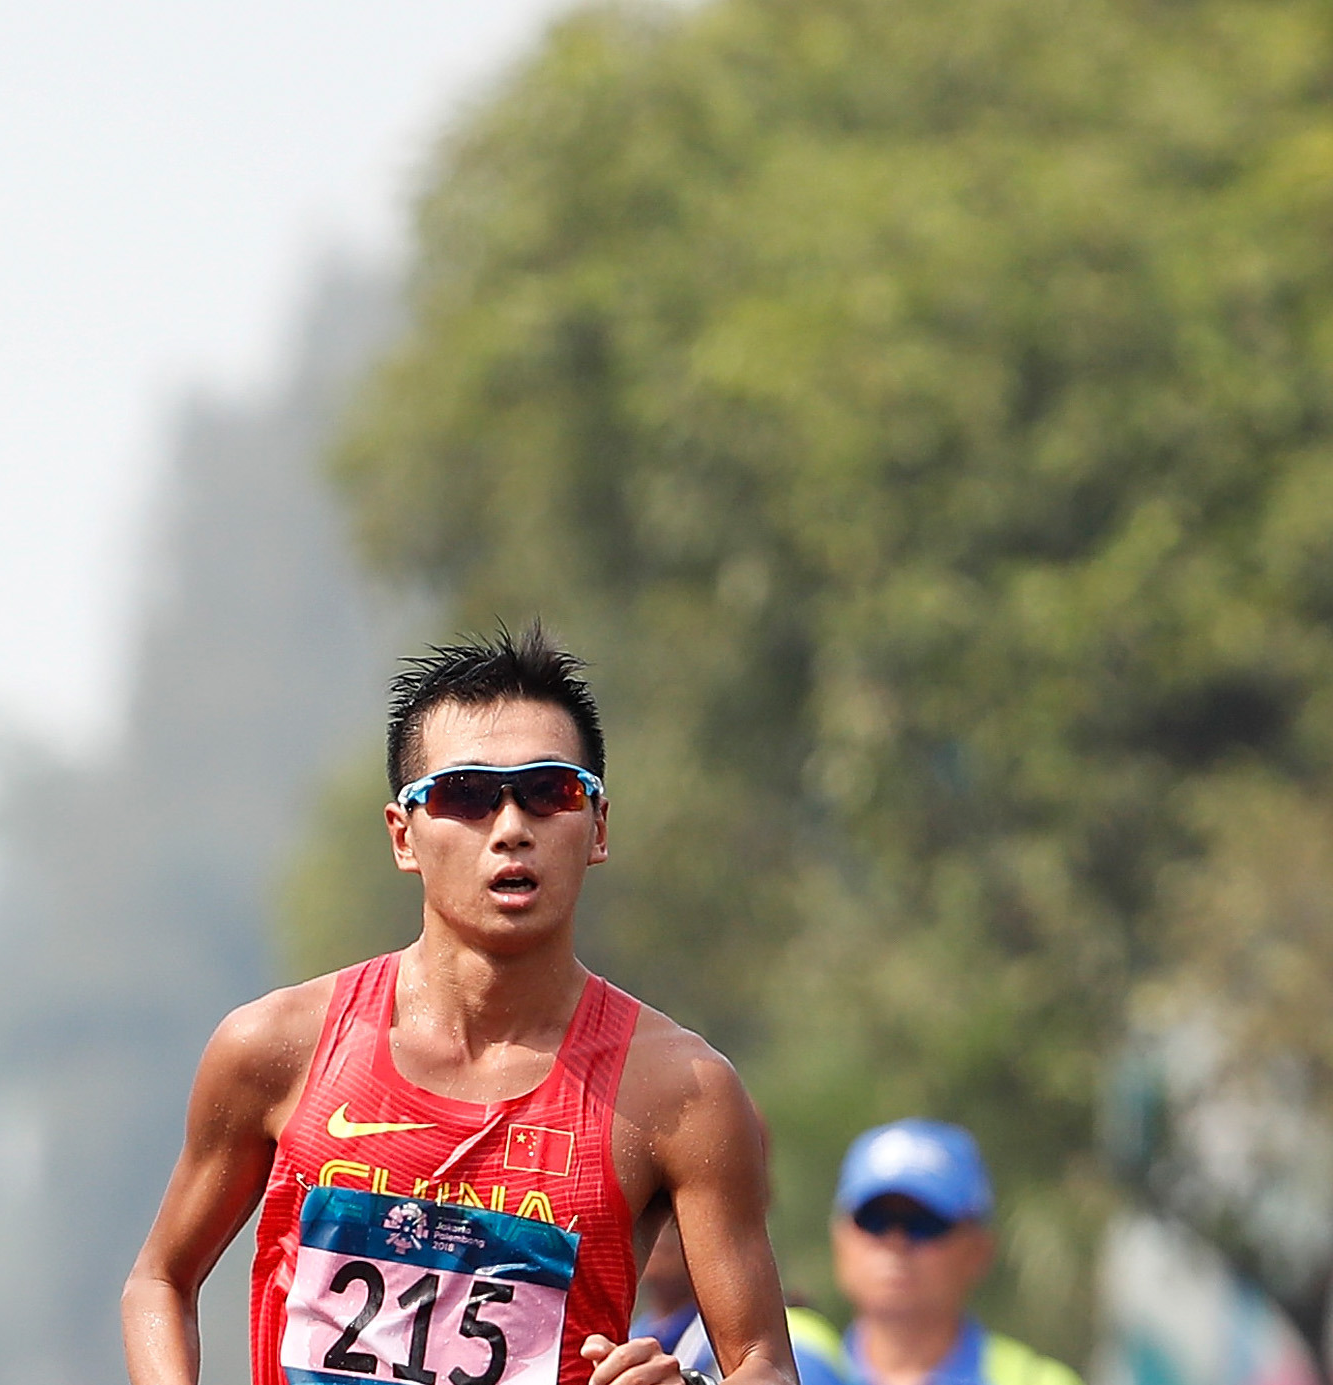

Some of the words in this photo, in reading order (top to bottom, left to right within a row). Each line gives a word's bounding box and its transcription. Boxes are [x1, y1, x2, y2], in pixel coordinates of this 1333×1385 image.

[435, 1221, 472, 1235] Jakarta
[432, 1241, 455, 1252] 2018
[433, 1230, 486, 1249] Palembang
